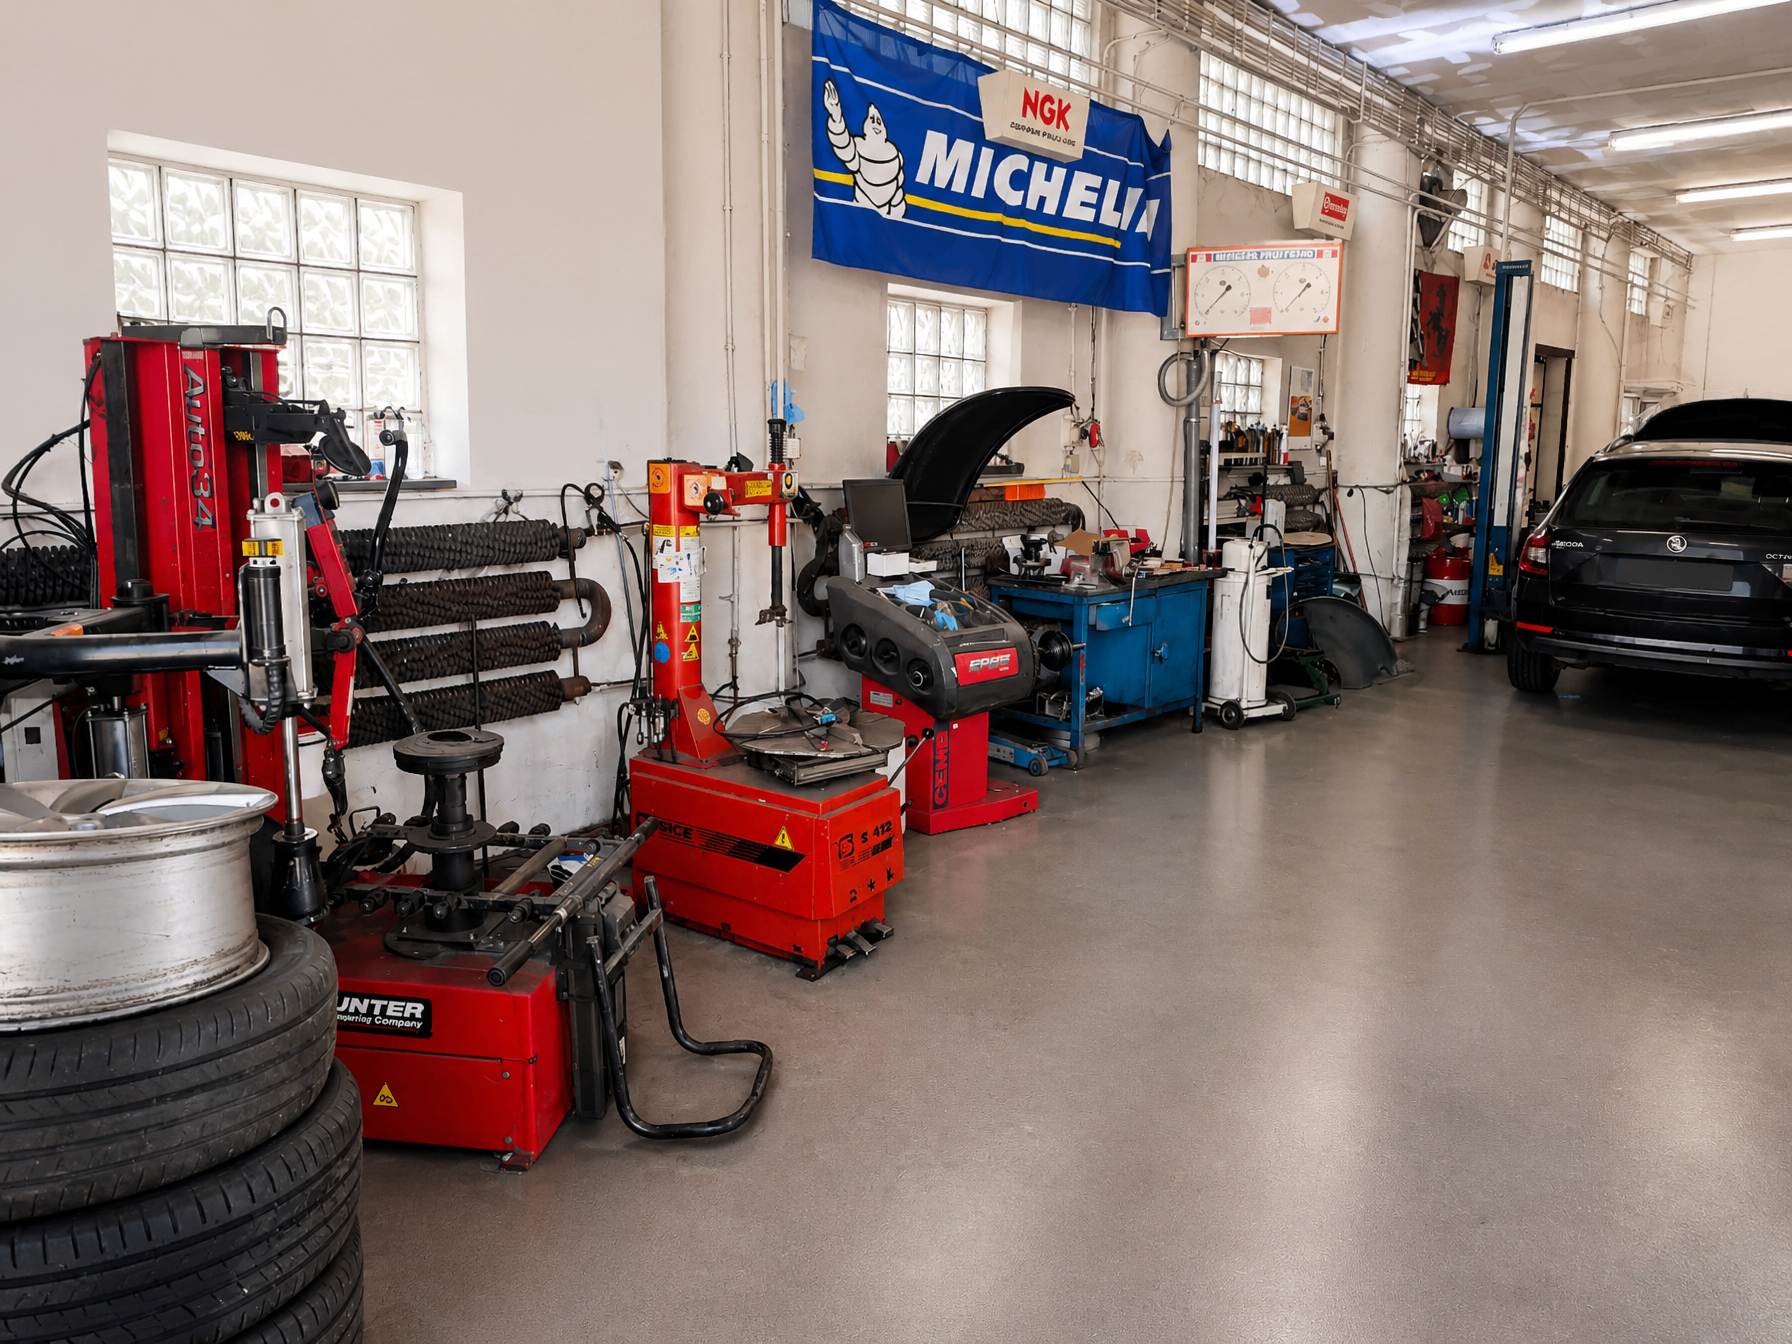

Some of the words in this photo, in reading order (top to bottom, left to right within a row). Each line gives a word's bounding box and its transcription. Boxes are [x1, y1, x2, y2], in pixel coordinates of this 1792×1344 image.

[1022, 86, 1072, 132] NGK
[659, 820, 693, 840] SICE
[861, 831, 868, 844] S
[873, 821, 892, 837] 412
[337, 997, 425, 1018] UNTER
[374, 1016, 423, 1029] Company
